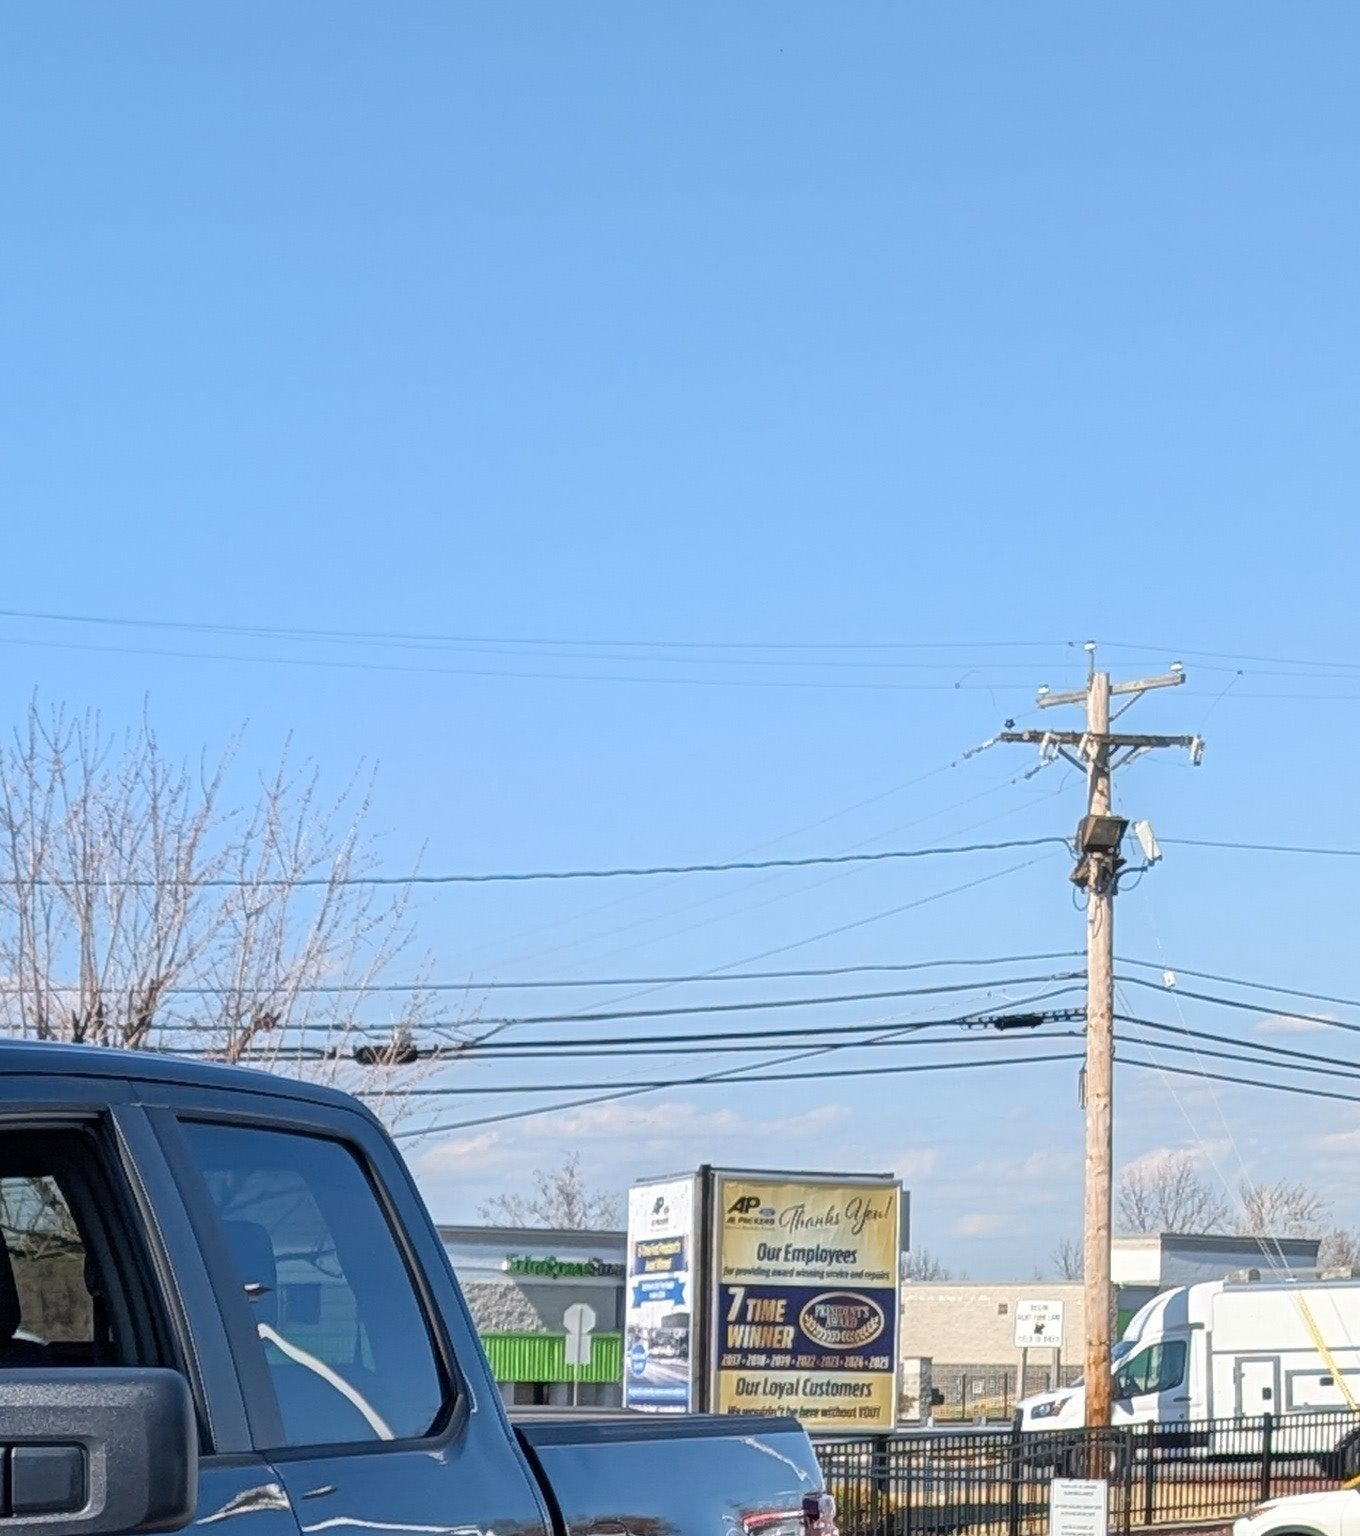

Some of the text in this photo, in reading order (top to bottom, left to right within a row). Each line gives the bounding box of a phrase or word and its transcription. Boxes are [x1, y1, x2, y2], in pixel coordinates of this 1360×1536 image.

[727, 1196, 761, 1214] AP
[779, 1196, 894, 1236] Thanks You!
[757, 1242, 858, 1266] Our Employees
[735, 1267, 770, 1279] providing
[796, 1269, 824, 1280] winning
[850, 1270, 864, 1280] and
[727, 1286, 787, 1322] 7 TIME
[726, 1324, 795, 1349] WINNER
[735, 1377, 873, 1399] Our Loyal Customers
[821, 1407, 857, 1419] without
